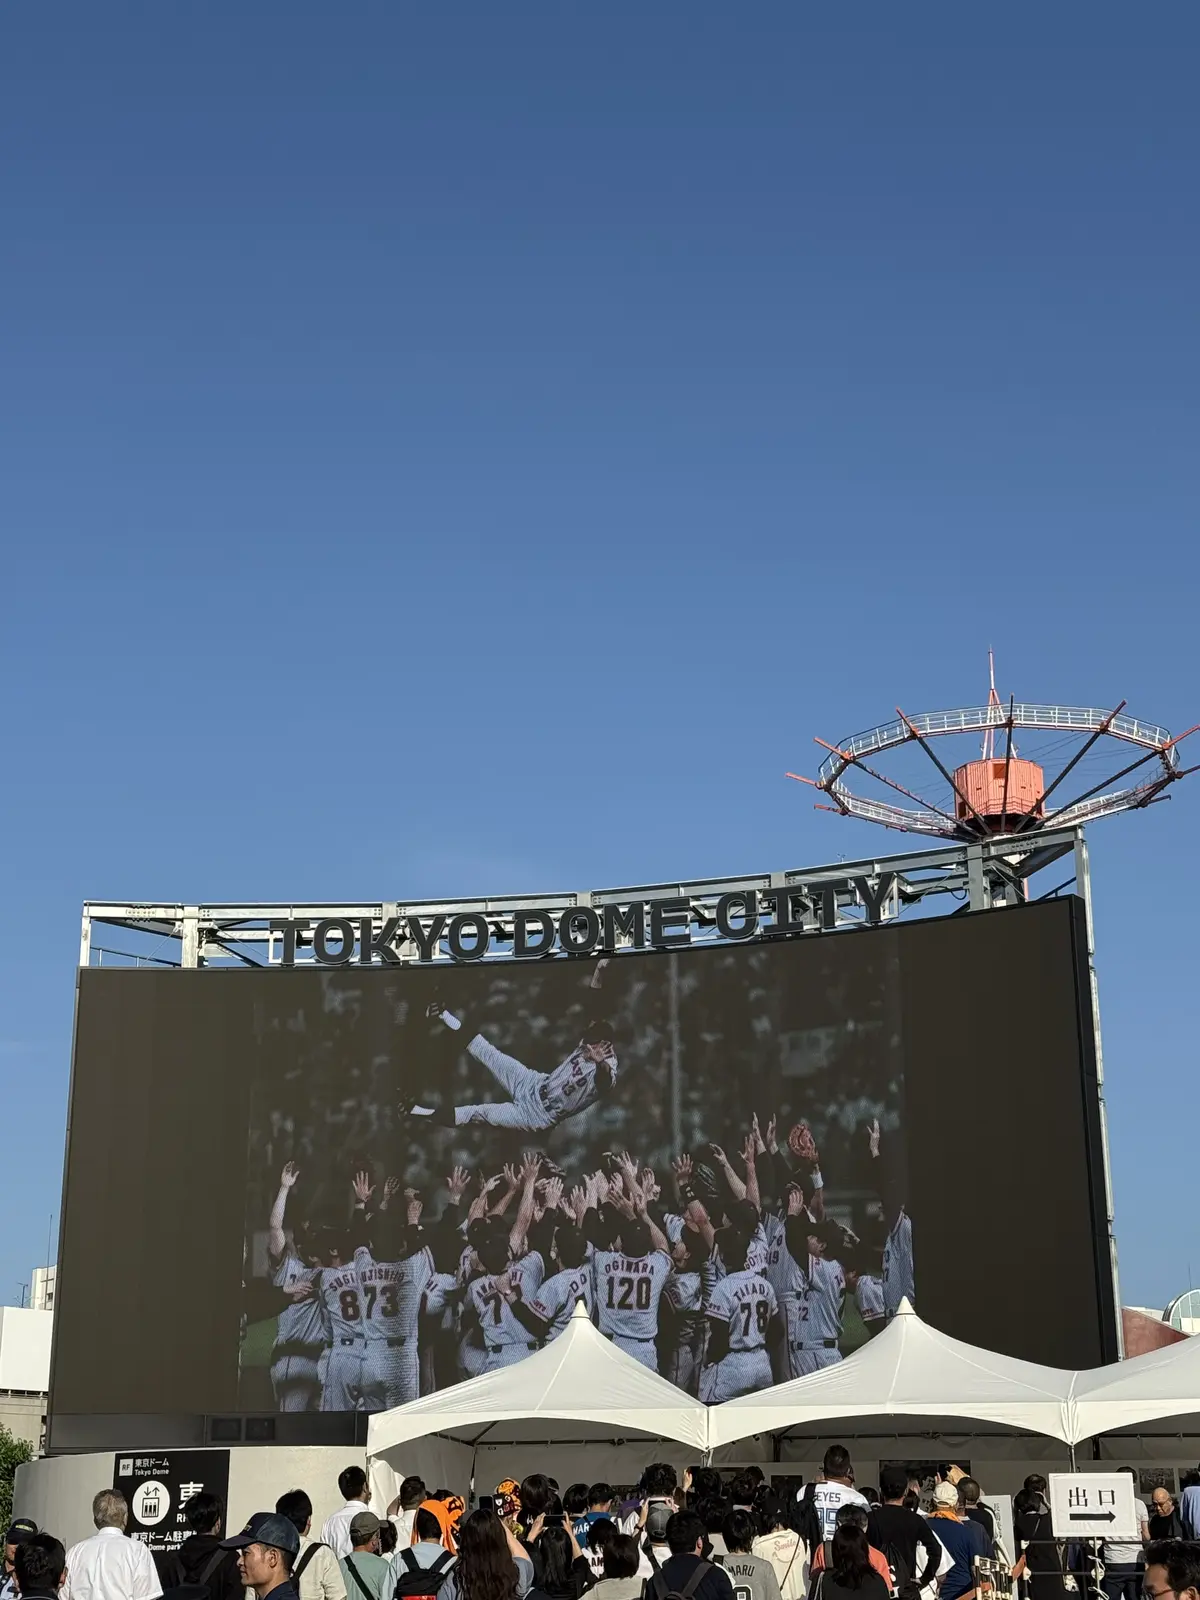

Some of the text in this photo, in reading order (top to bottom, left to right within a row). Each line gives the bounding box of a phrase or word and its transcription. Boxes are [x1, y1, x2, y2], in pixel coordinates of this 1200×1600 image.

[268, 873, 898, 966] TOKYO DOME CITY
[363, 1284, 399, 1320] 73
[604, 1276, 652, 1310] 120
[740, 1299, 769, 1337] 78
[134, 1457, 170, 1468] 東京ドーム
[134, 1468, 170, 1477] Tokyo Dome
[814, 1491, 841, 1503] EYES
[1068, 1487, 1115, 1508] 出口
[131, 1530, 198, 1543] 東京ドーム駐車
